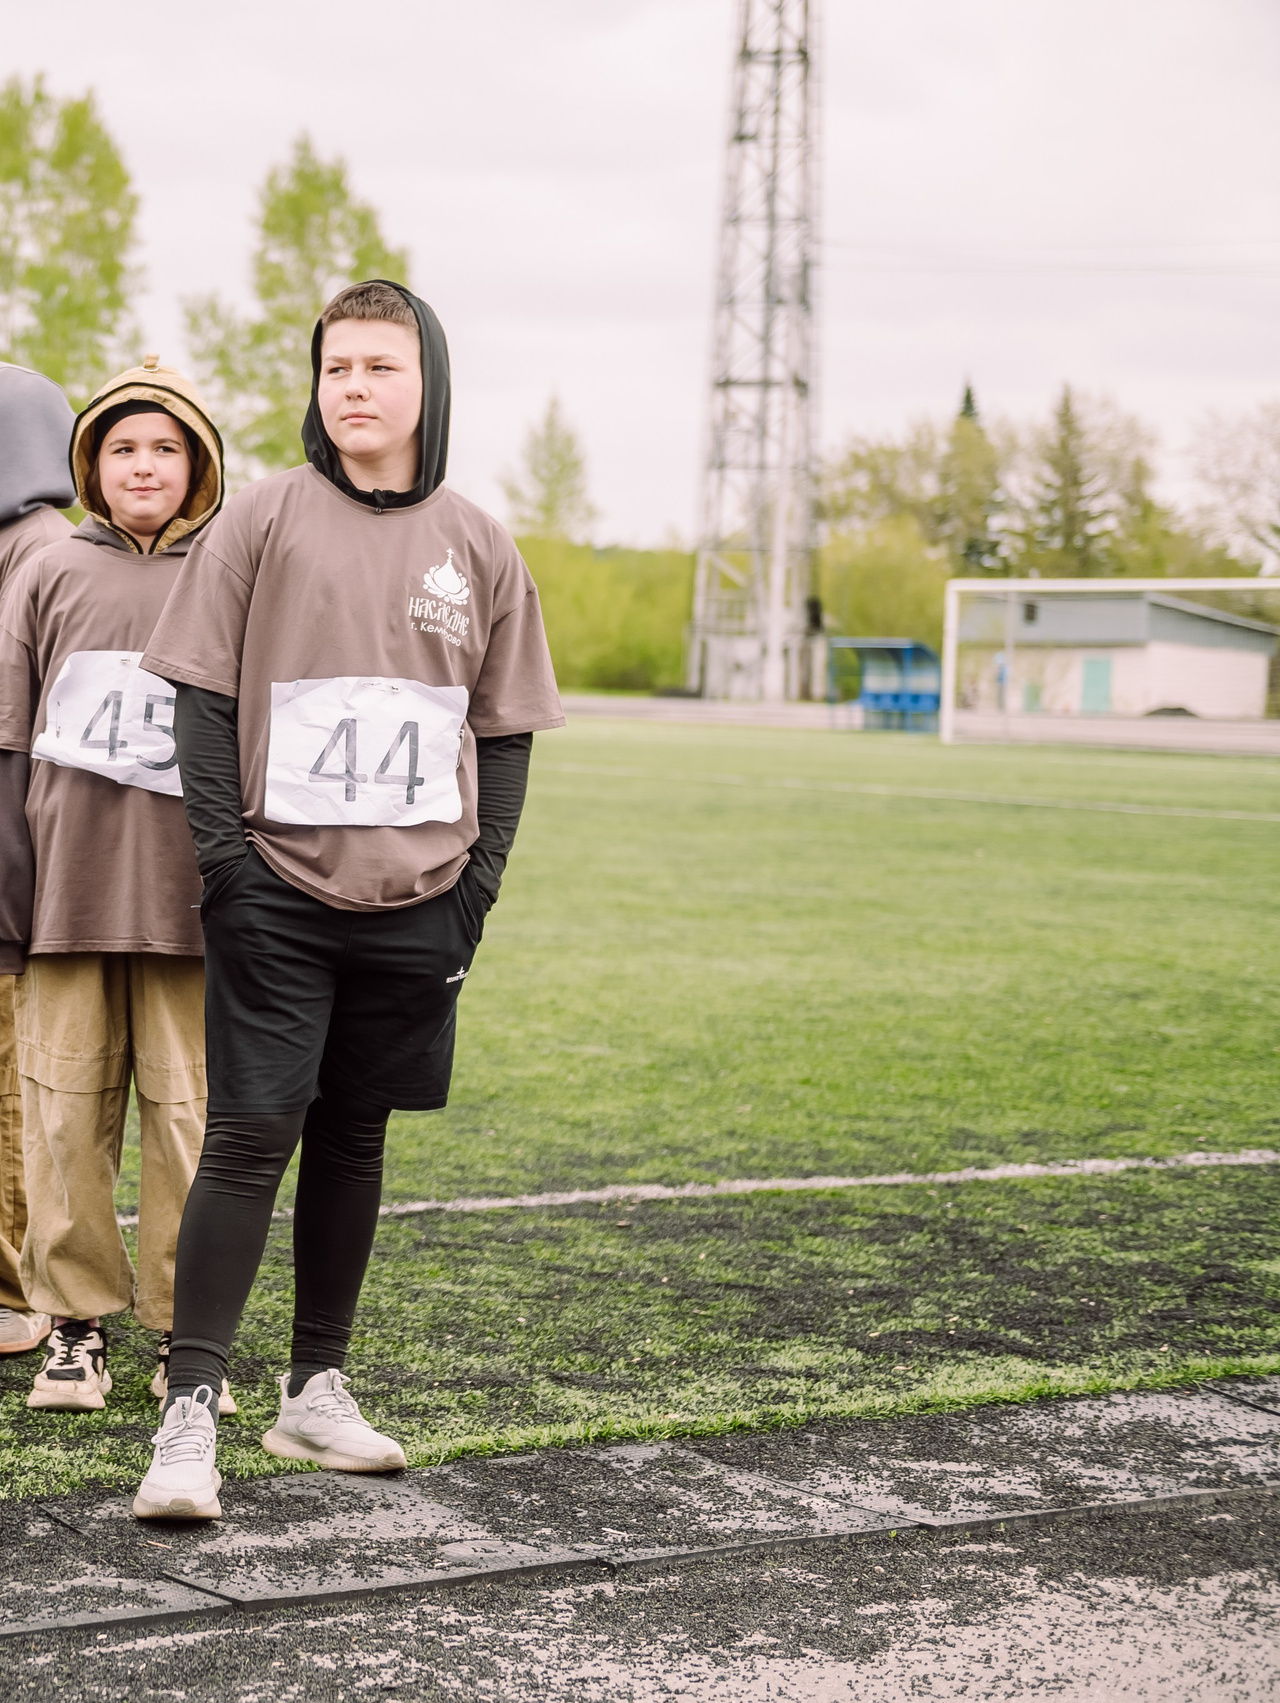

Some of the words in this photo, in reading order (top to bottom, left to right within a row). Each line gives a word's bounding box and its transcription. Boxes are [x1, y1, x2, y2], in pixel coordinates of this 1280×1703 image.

[410, 622, 418, 631] г.
[79, 690, 178, 771] 45
[308, 718, 425, 805] 44
